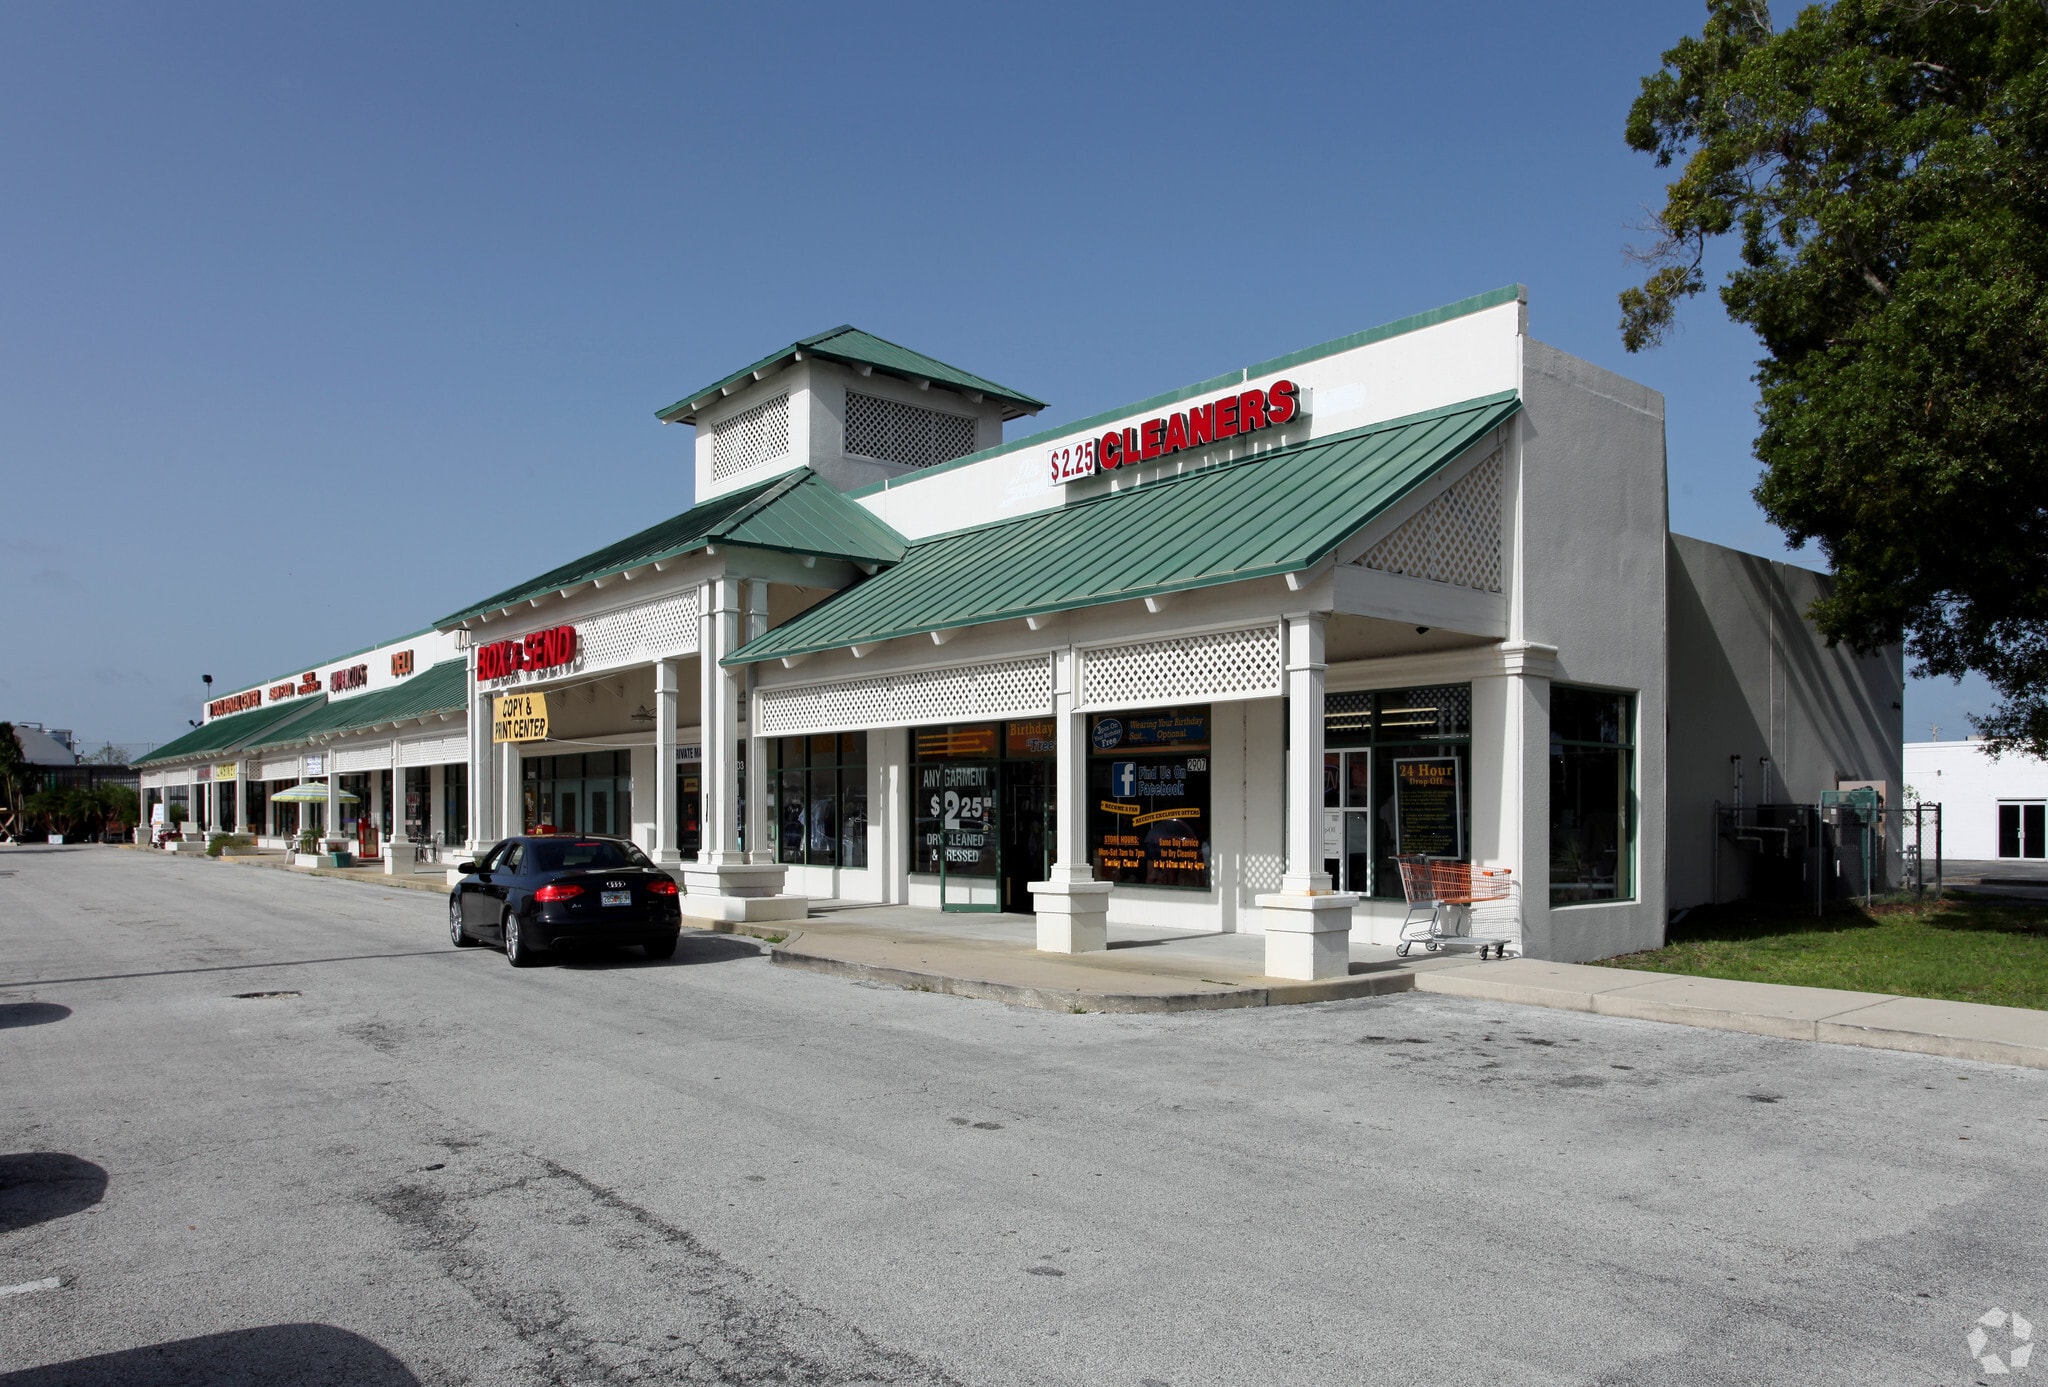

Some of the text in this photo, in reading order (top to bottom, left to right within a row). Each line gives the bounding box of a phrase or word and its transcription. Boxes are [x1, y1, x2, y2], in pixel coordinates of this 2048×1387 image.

[1051, 379, 1299, 483] $2.25 CLEANERS
[478, 641, 509, 681] BOX
[523, 625, 576, 672] SEND
[391, 649, 414, 677] DELI
[330, 663, 368, 692] SUPERCUTS
[280, 682, 295, 698] FOOD
[224, 694, 240, 714] RENTAL
[241, 690, 261, 709] CENTER
[503, 697, 532, 718] COPY &
[514, 718, 546, 738] CENTER
[1130, 716, 1204, 729] Wearing Your Birthday
[1010, 723, 1053, 736] Birthday
[1104, 728, 1121, 739] Birthday
[1101, 737, 1118, 748] Free
[676, 747, 694, 759] RIVATE
[1187, 759, 1207, 771] 2907
[1400, 764, 1453, 777] 24 Hour
[923, 767, 988, 787] ANY GARMENT
[1138, 765, 1186, 779] Find Us On
[1138, 781, 1185, 796] Facebook
[1105, 803, 1124, 811] BECOME
[1155, 811, 1181, 819] EXCLUSIVE
[1104, 835, 1139, 844] STORE HOURS:
[1172, 838, 1181, 849] Day
[1182, 838, 1199, 847] Service
[931, 849, 979, 862] & RESSED
[1168, 849, 1176, 859] Dry
[1177, 849, 1197, 859] Cleaning
[1123, 859, 1139, 867] Closed
